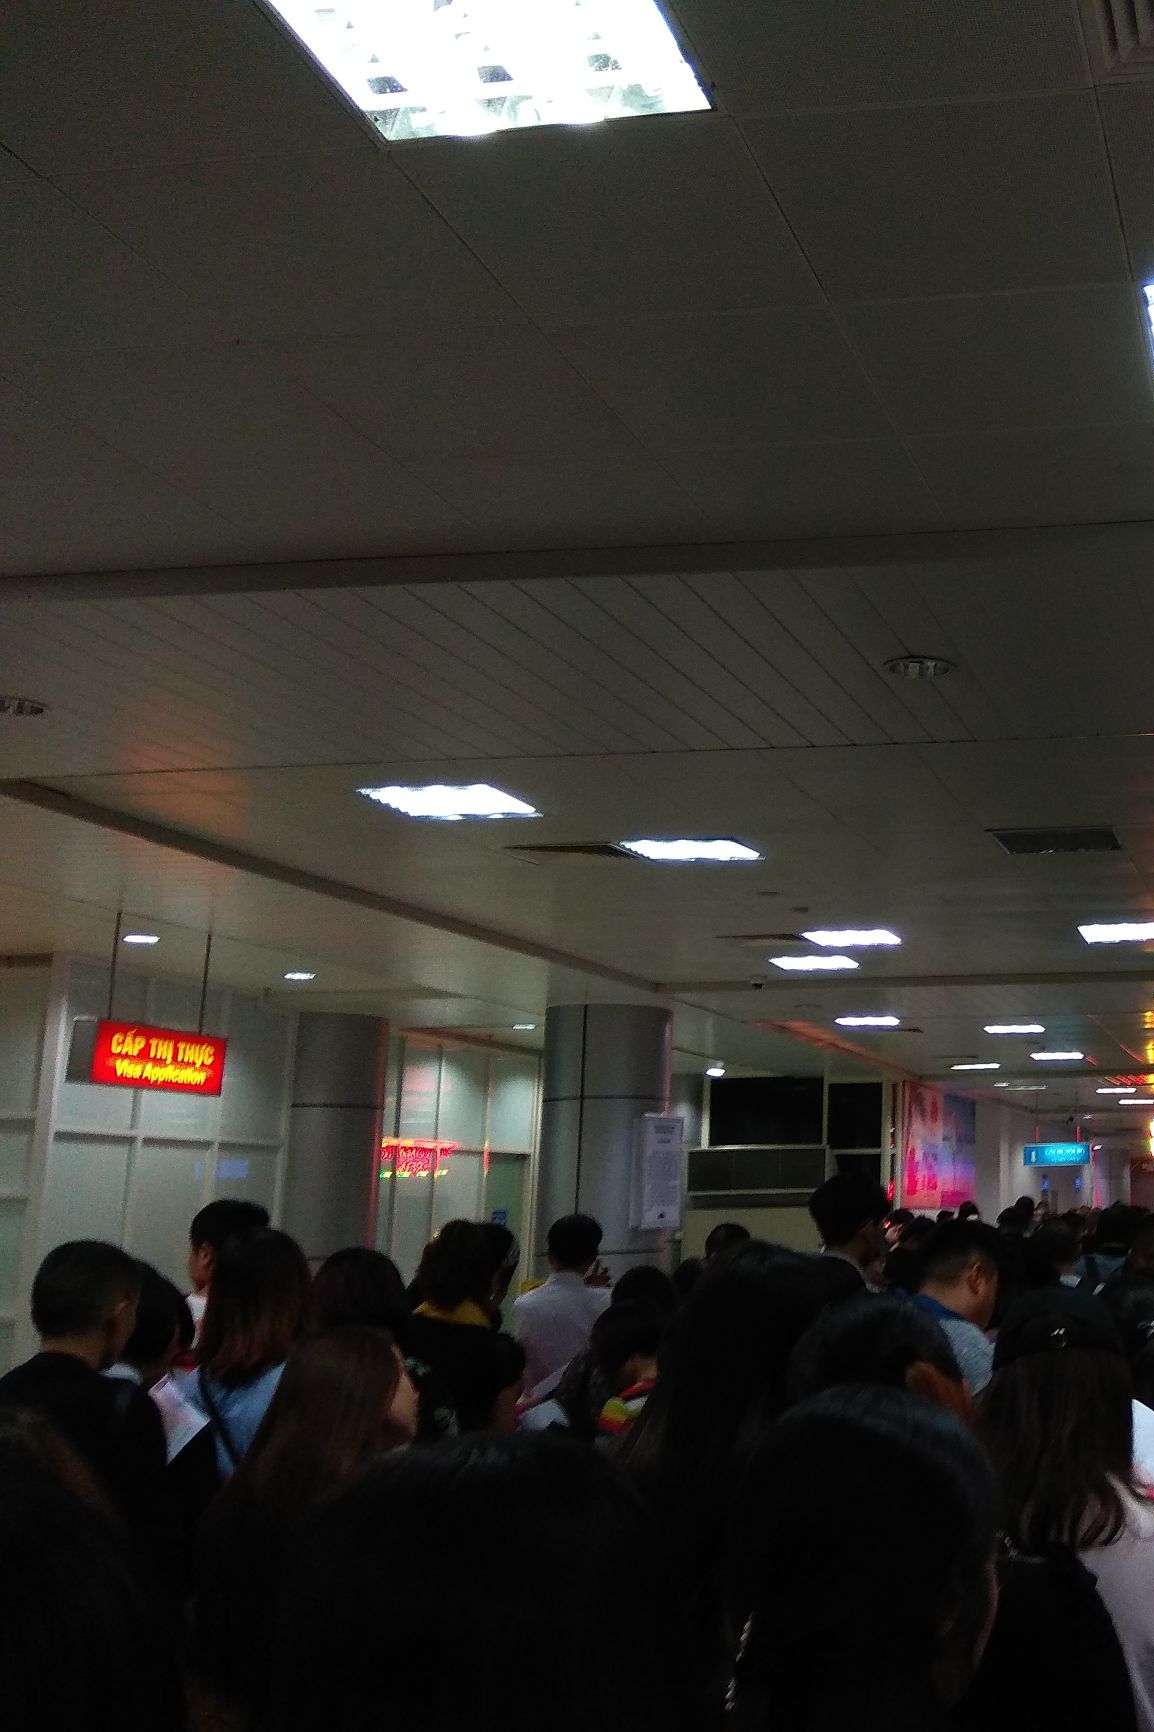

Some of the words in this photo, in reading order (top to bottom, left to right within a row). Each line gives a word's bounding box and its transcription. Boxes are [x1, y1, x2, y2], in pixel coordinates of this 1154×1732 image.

[111, 1029, 146, 1056] CẤP
[149, 1037, 174, 1064] THỊ
[177, 1042, 215, 1067] THỰC
[115, 1059, 143, 1079] Visa
[142, 1063, 207, 1085] Application
